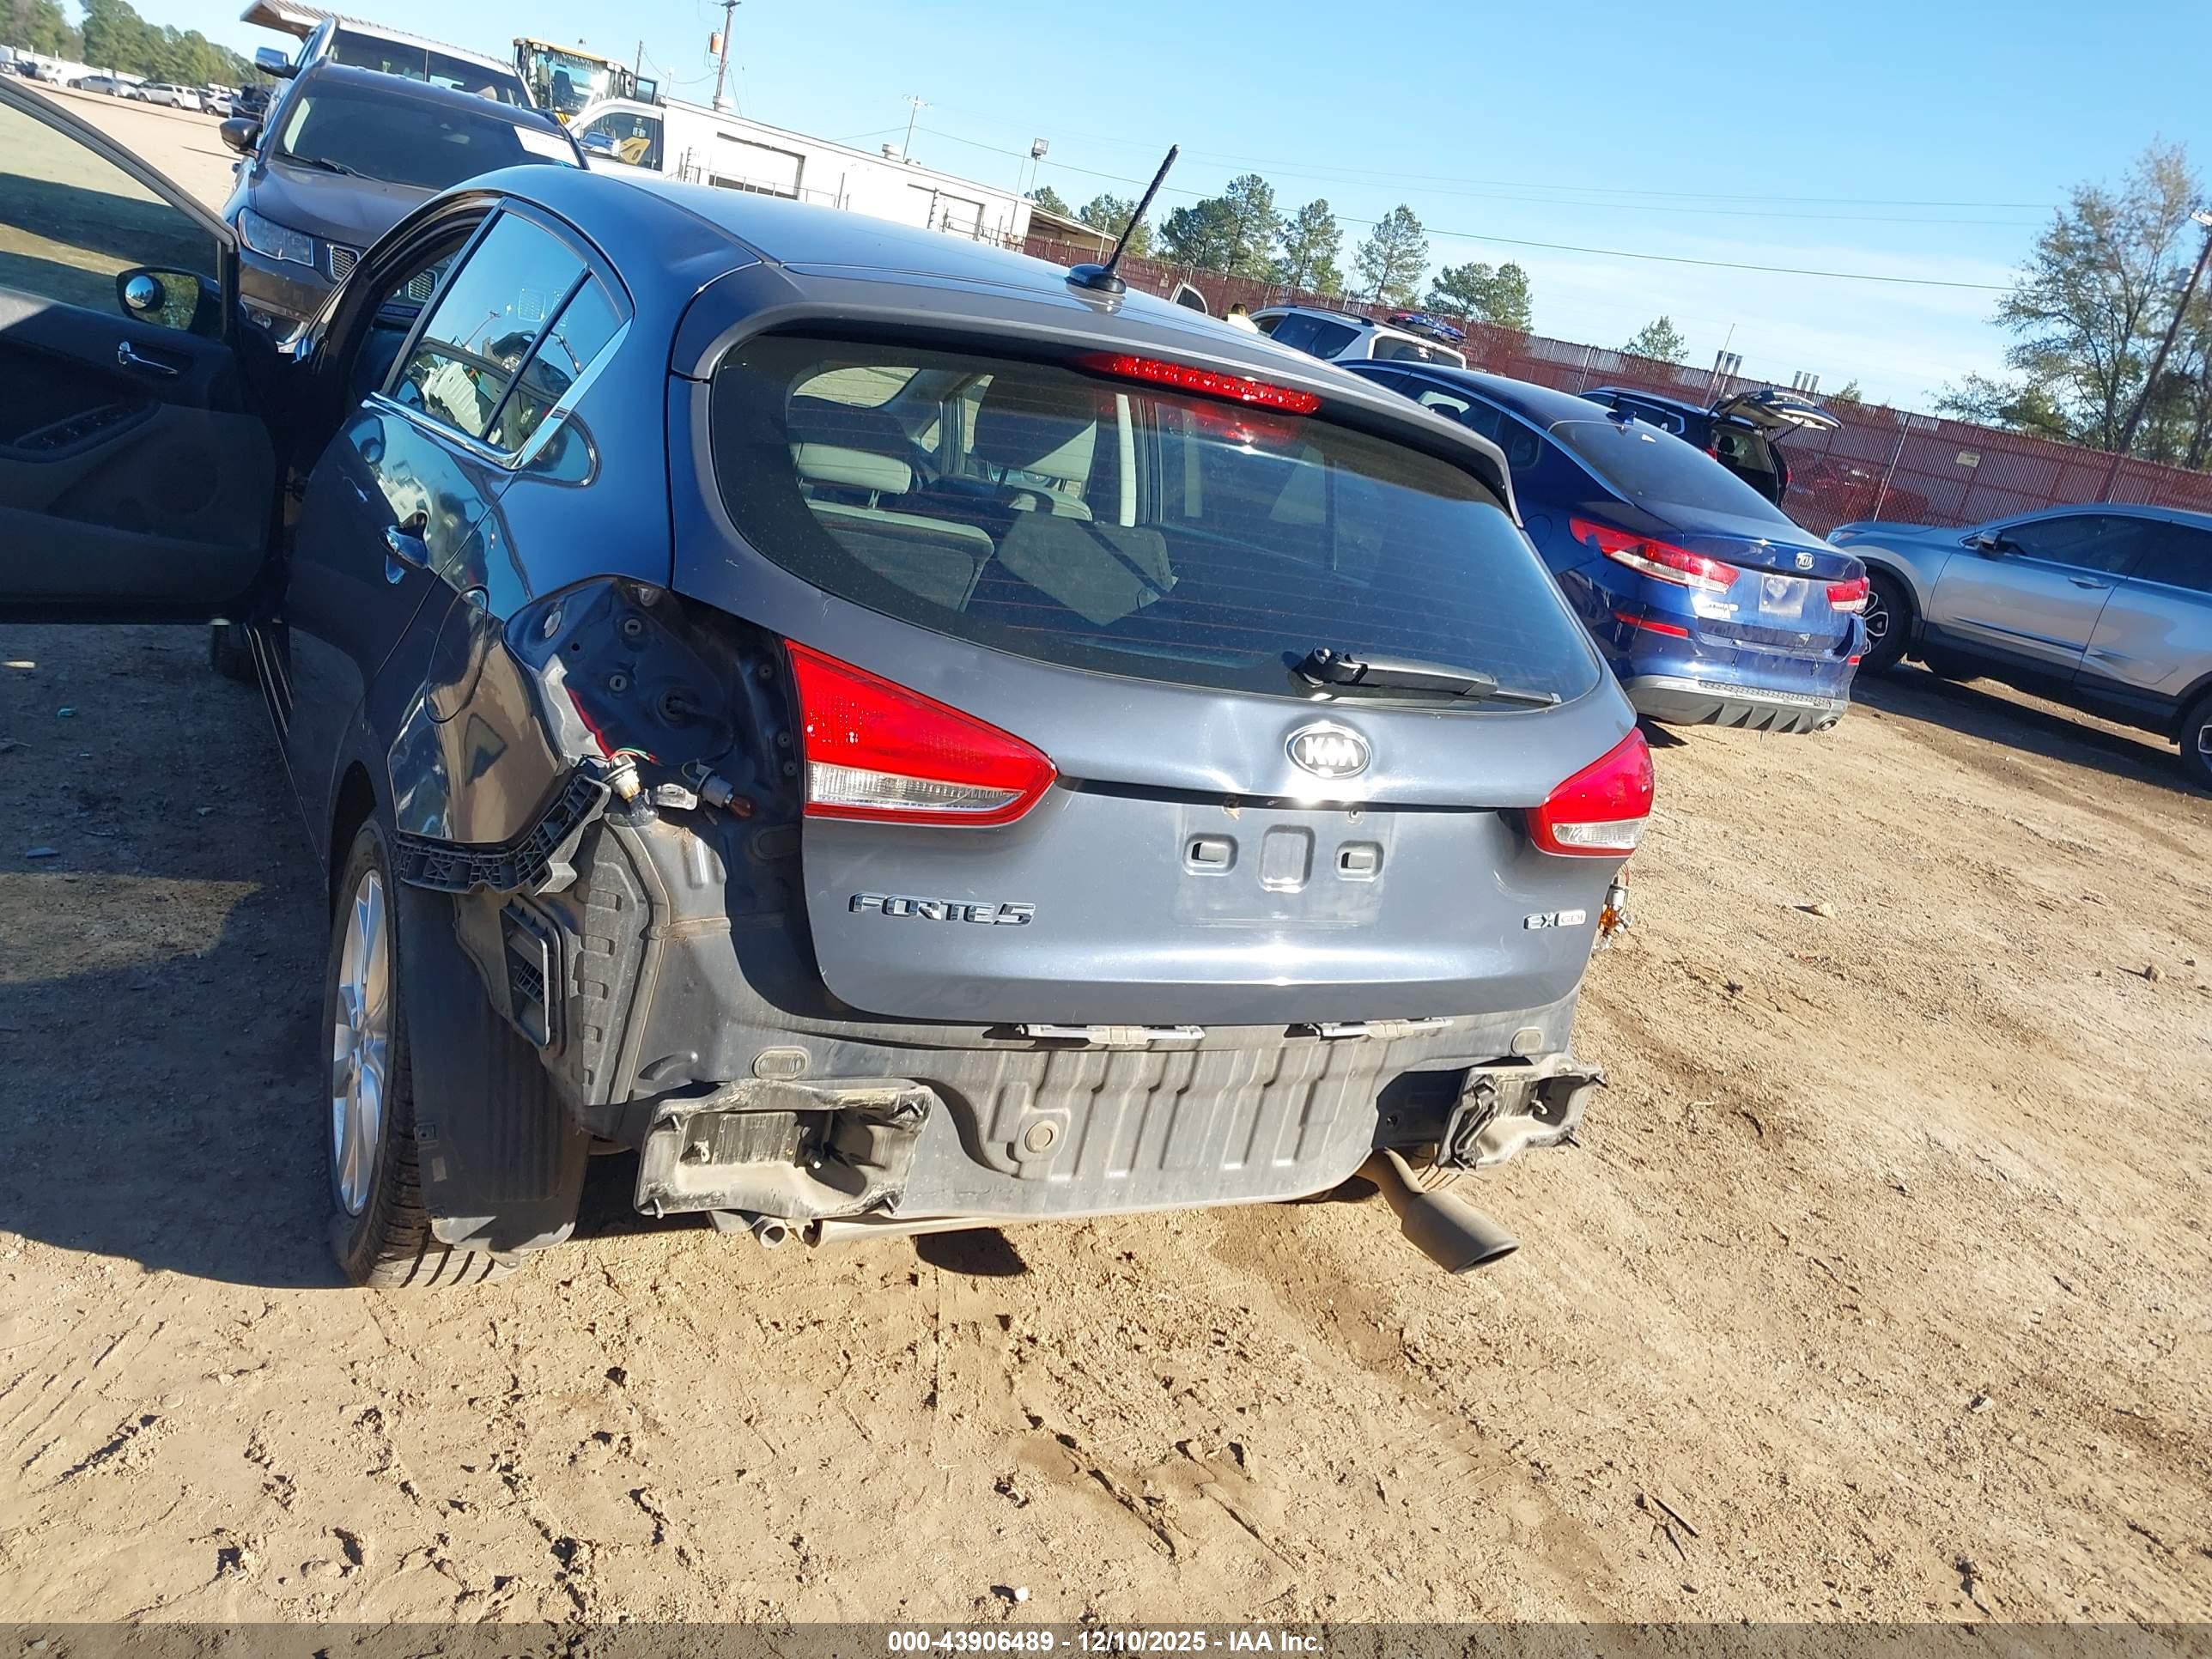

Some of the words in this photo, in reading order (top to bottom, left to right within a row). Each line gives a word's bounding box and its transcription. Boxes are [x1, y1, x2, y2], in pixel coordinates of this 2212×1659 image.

[561, 52, 592, 65] VOLVO
[1798, 555, 1813, 567] KIA
[1304, 736, 1358, 767] KIA
